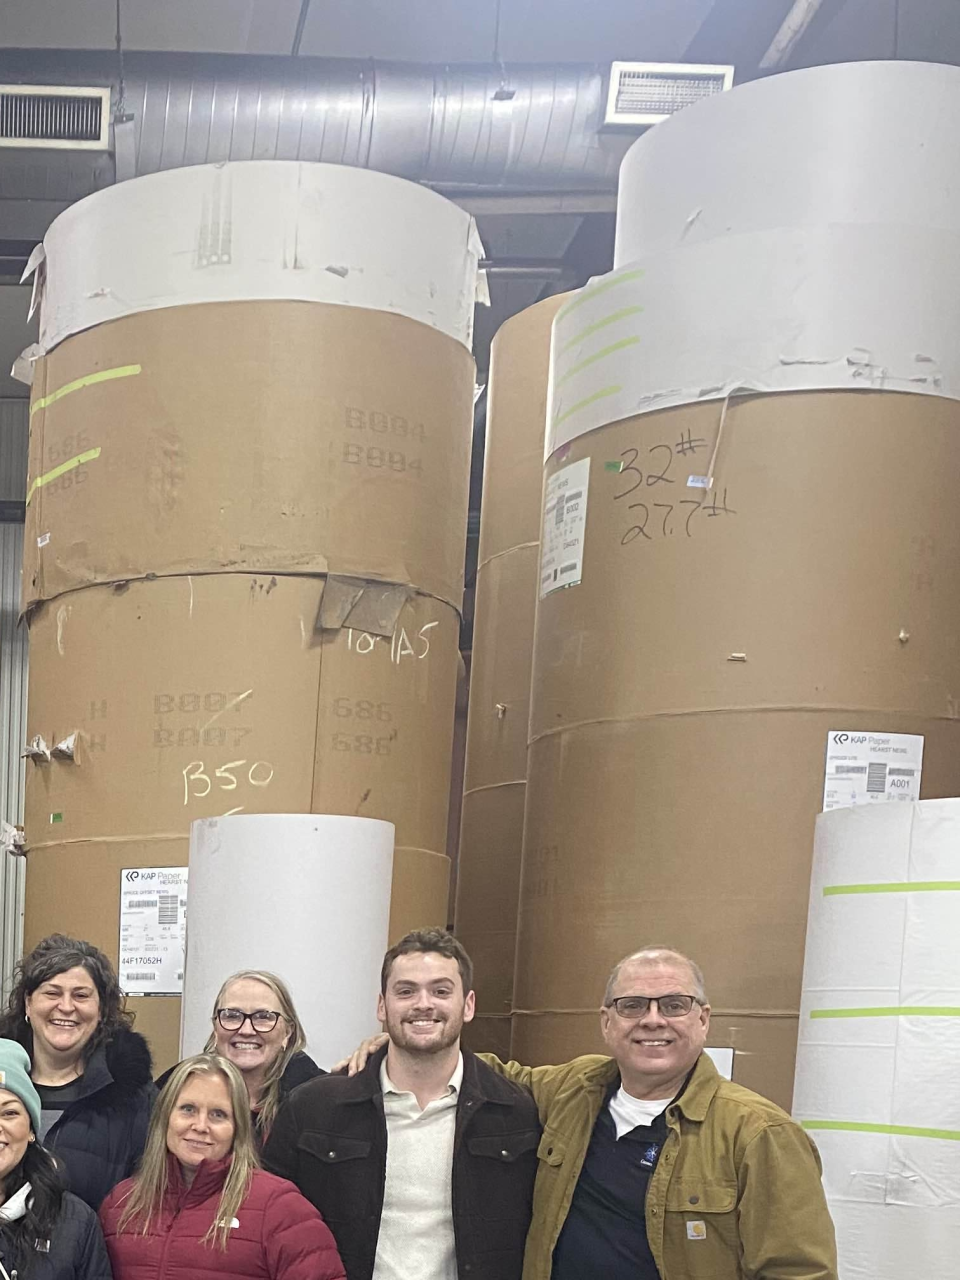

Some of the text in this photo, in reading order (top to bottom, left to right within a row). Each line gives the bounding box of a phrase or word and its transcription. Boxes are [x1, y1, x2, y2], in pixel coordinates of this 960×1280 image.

[851, 736, 891, 746] KAP Paper
[182, 760, 274, 805] B50
[890, 779, 910, 788] A001
[141, 871, 181, 881] KAP Paper
